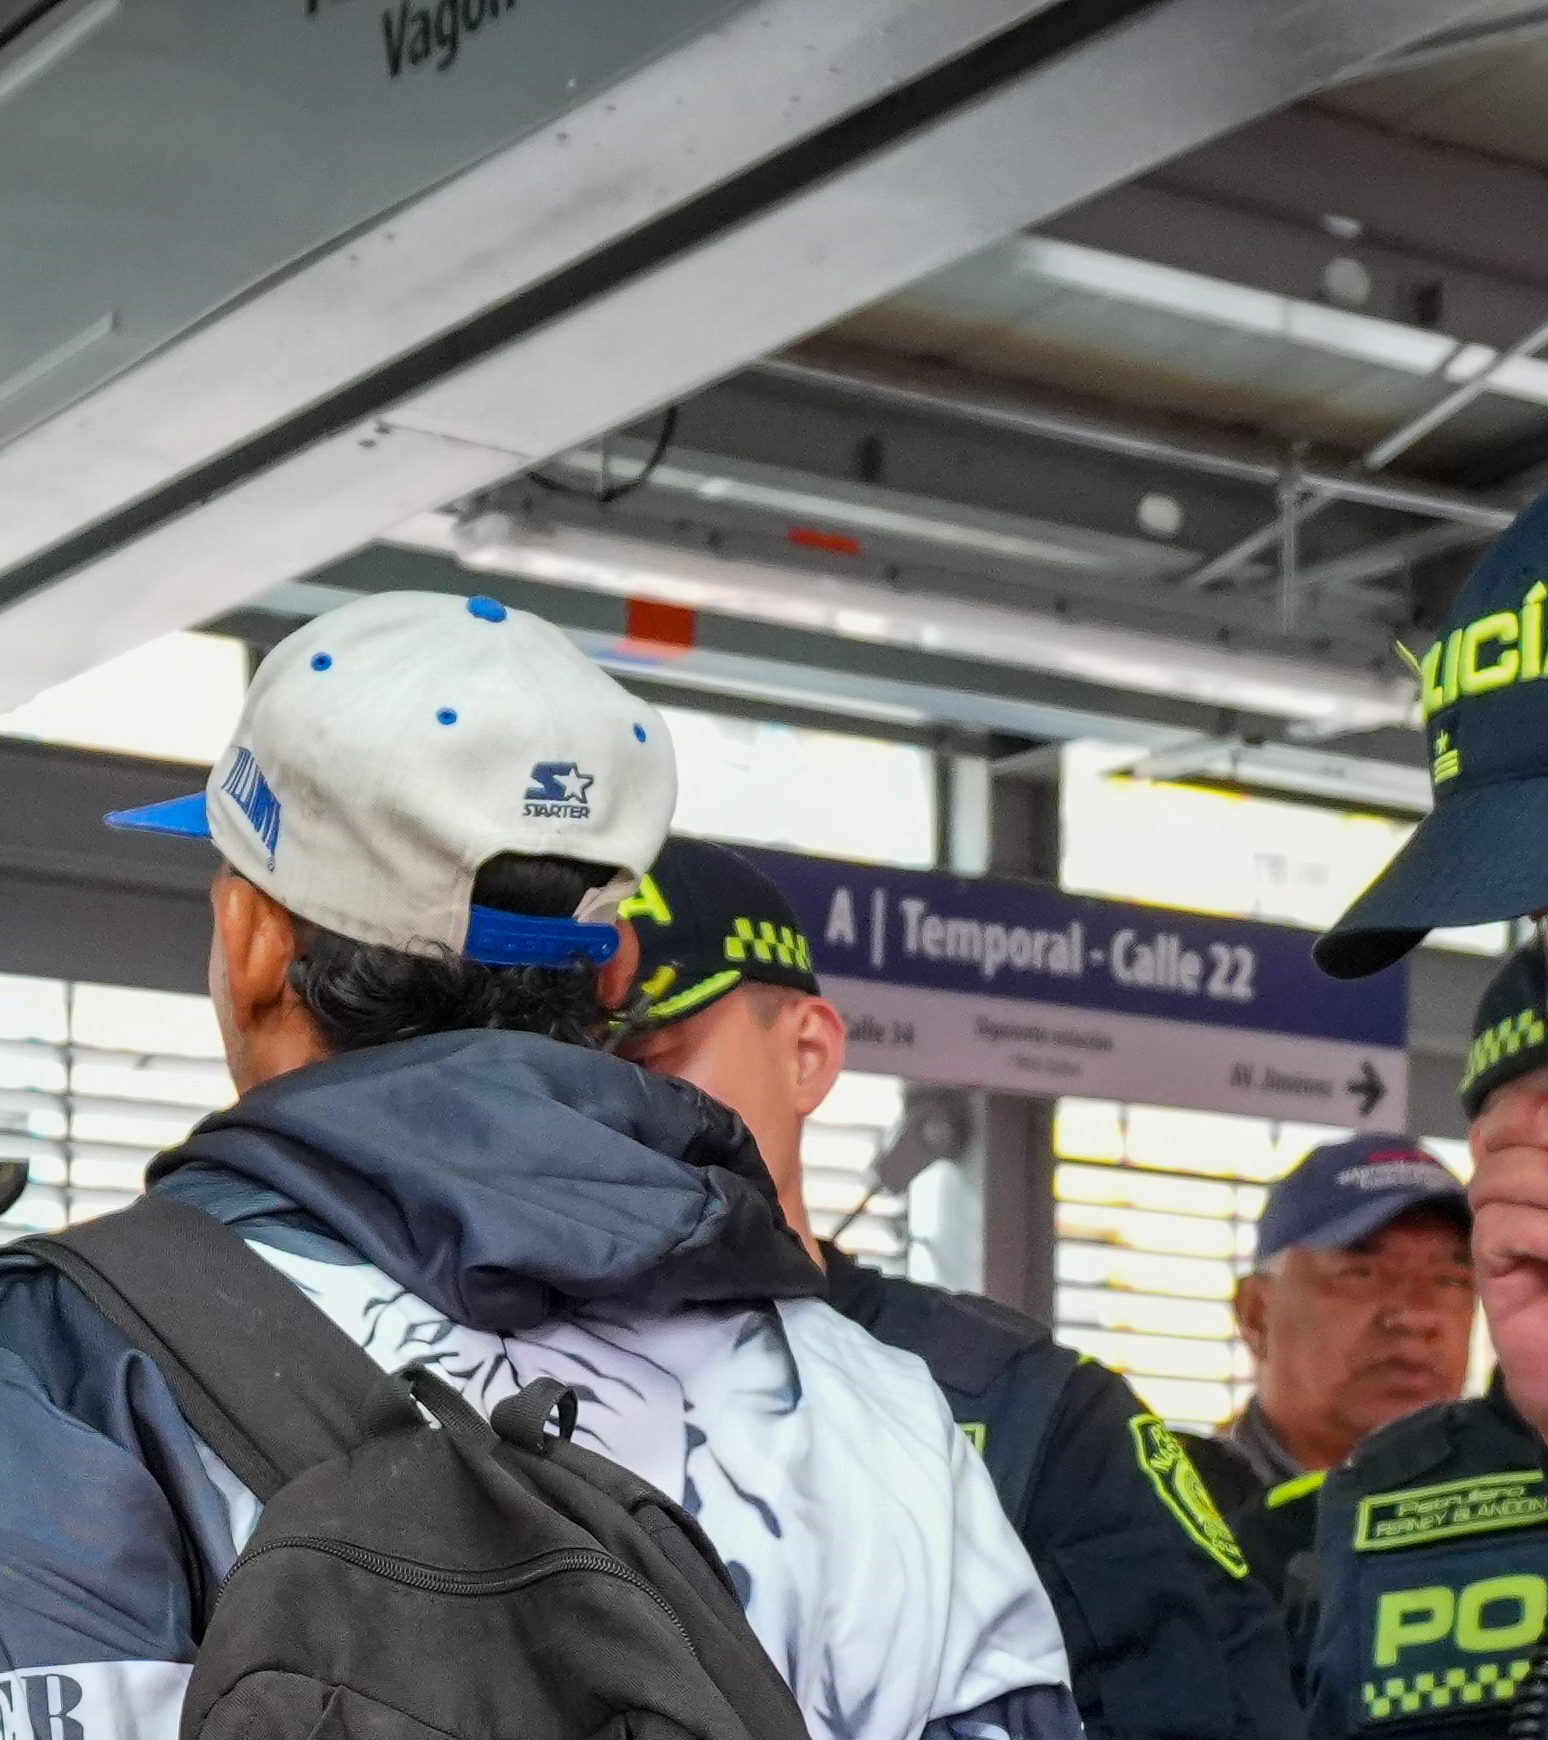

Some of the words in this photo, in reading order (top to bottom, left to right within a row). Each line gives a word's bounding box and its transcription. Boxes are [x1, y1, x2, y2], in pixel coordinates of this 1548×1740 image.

[522, 803, 591, 818] STARTER
[825, 885, 856, 947] A
[900, 899, 1084, 980] Temporal
[1110, 928, 1202, 995] Calle
[1207, 941, 1256, 1001] 22
